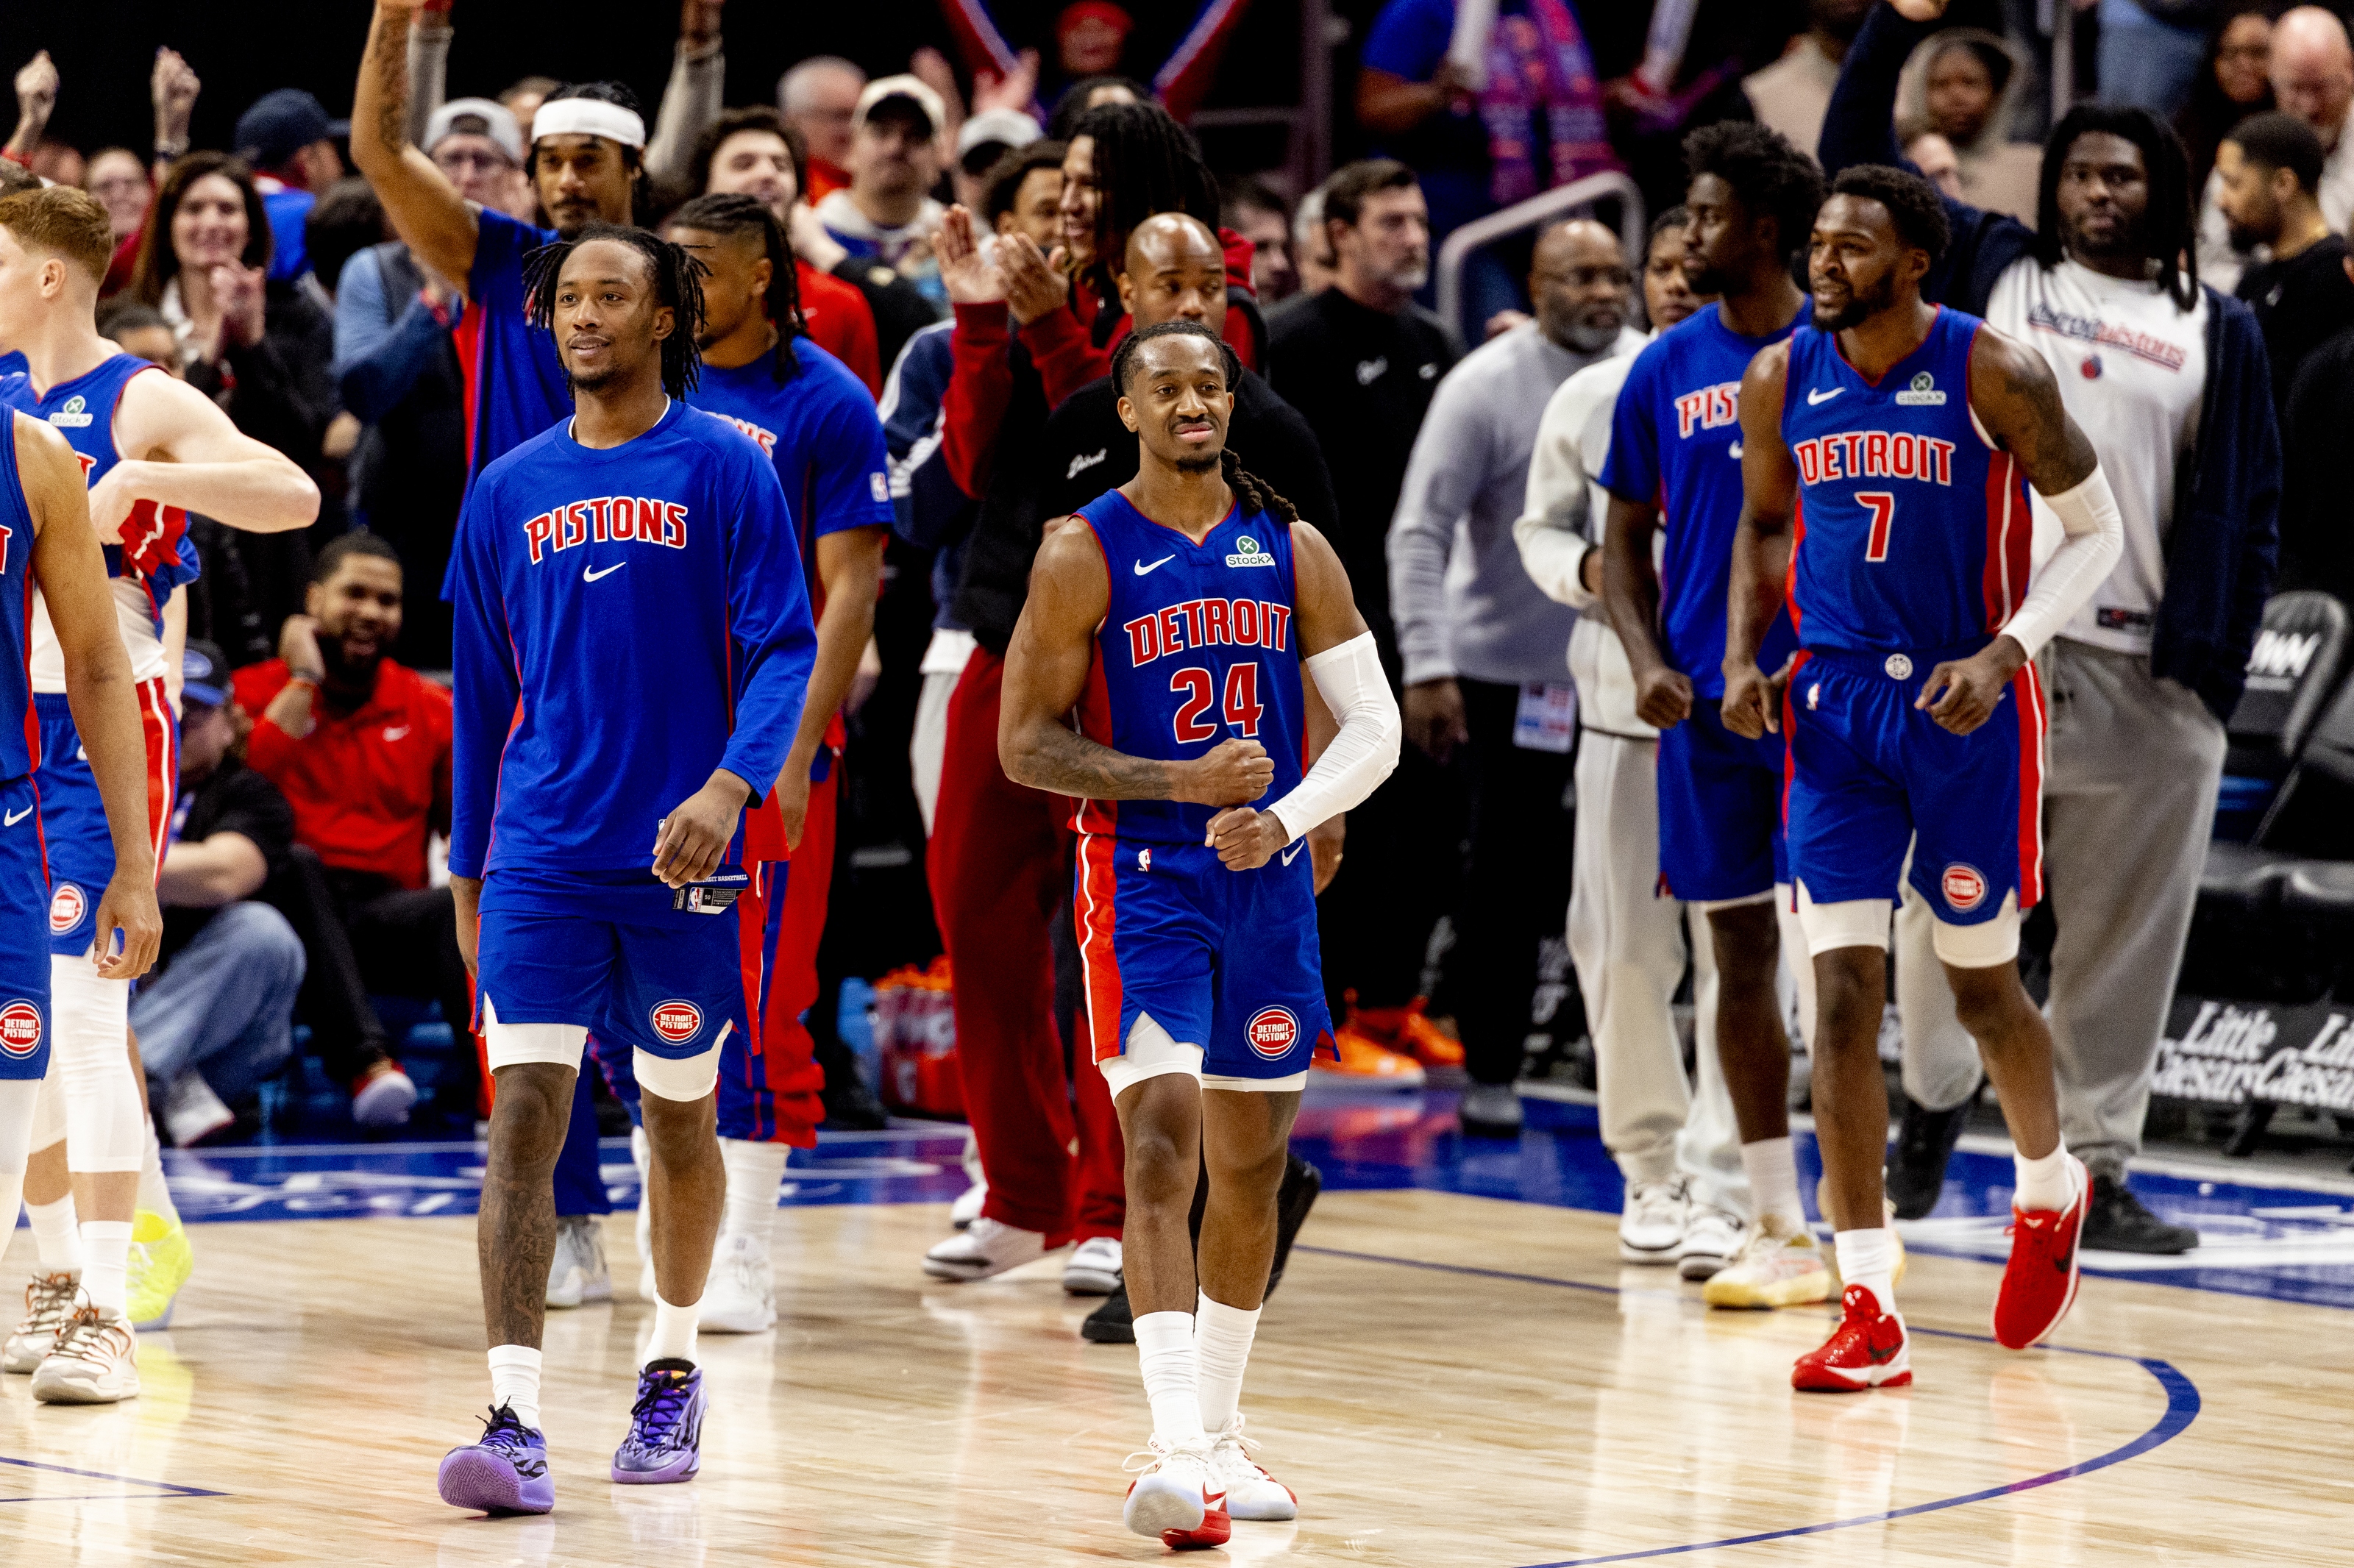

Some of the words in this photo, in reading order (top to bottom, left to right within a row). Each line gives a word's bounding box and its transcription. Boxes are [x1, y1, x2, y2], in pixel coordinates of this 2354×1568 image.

[1793, 431, 1956, 486] DETROIT
[524, 496, 689, 566] PISTONS
[1854, 491, 1895, 563] 7
[1228, 554, 1275, 566] StockX
[1123, 597, 1291, 668] DETROIT
[1170, 662, 1264, 744] 24
[717, 874, 748, 882] BASKETBALL
[4, 1019, 36, 1028] DETROIT
[660, 1013, 693, 1022] DETROIT
[659, 1020, 693, 1029] PISTONS
[1256, 1023, 1289, 1033] DETROIT
[2177, 1001, 2277, 1060] Little
[4, 1027, 35, 1038] PISTONS
[1256, 1031, 1290, 1041] PISTONS
[2252, 1047, 2354, 1111] Caesar
